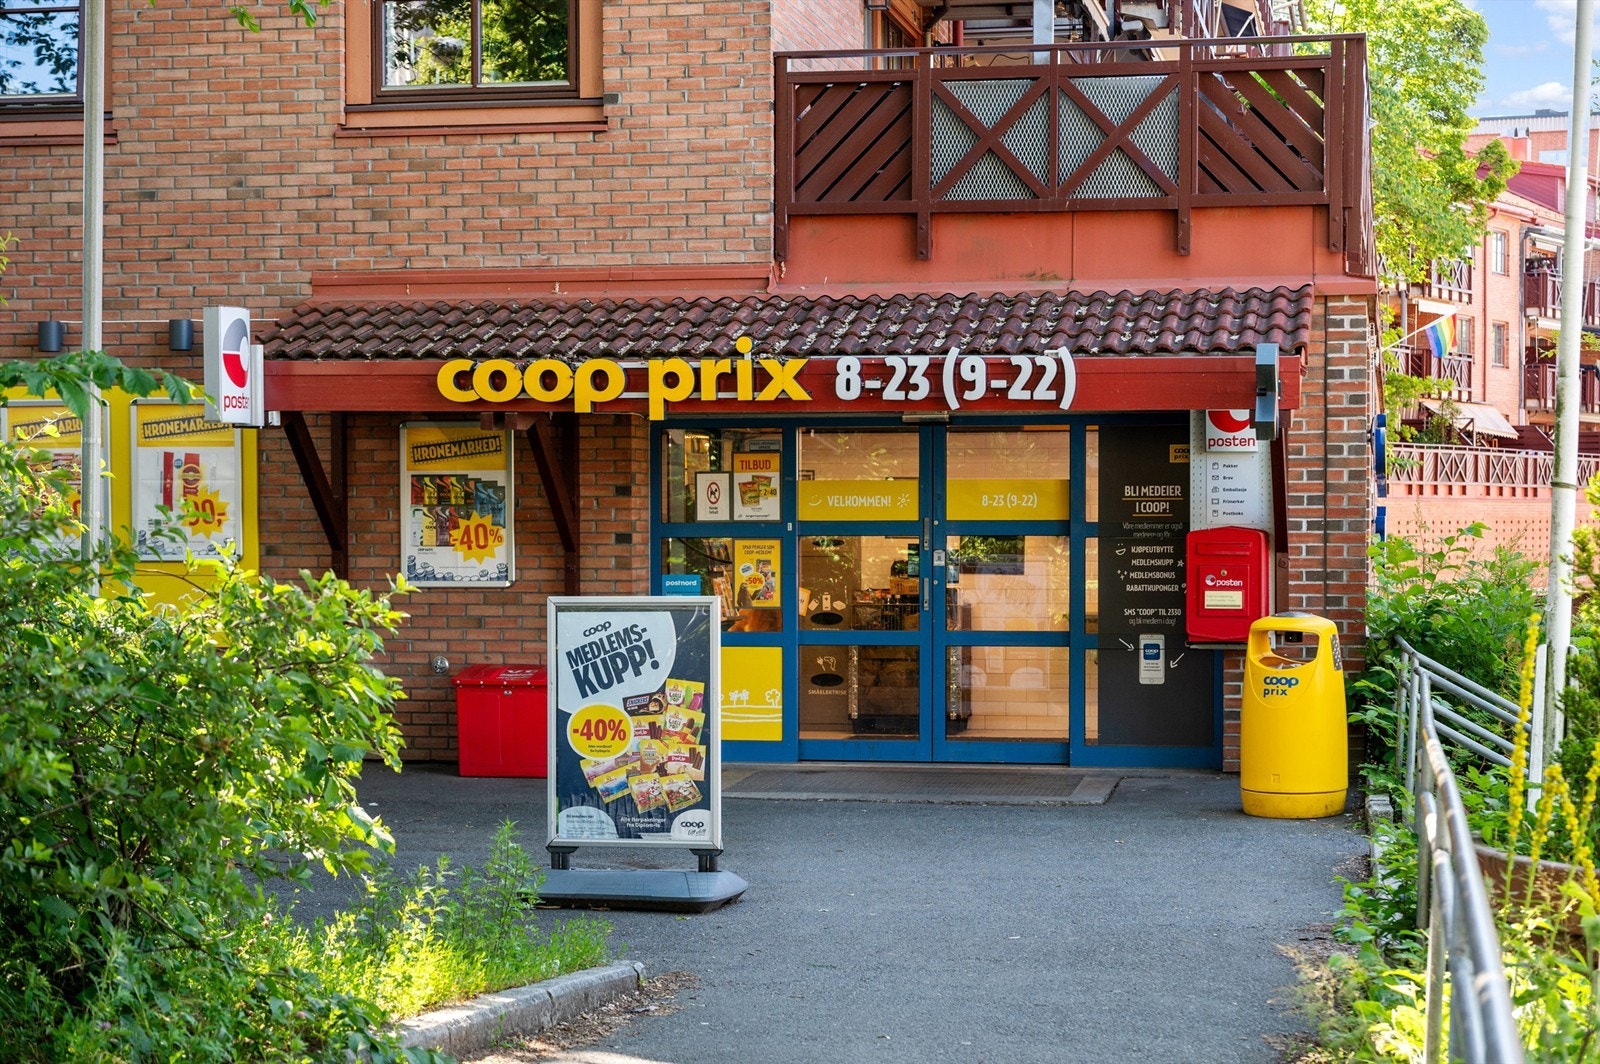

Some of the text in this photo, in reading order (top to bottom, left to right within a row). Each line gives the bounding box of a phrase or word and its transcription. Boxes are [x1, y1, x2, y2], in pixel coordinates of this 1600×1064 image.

[436, 336, 813, 421] coop prix
[835, 346, 1076, 410] 8-23 (9-22)
[224, 393, 250, 412] poste
[1208, 435, 1255, 449] posten
[413, 437, 501, 461] KRONEMARKED!
[739, 459, 771, 470] TILBUD
[1124, 485, 1182, 496] BLI MEDEIER
[827, 495, 892, 507] VELKOMMEN!
[981, 493, 1038, 508] 8-23 (9-22)
[1136, 502, 1170, 512] I COOP!
[451, 523, 503, 551] -40%
[1131, 545, 1174, 554] KJØPEUTBYTTE
[1131, 558, 1174, 566] MEDLEMSKUPP
[745, 577, 764, 585] -50%
[1129, 571, 1176, 579] MEDLEMSBONUS
[1126, 584, 1179, 592] RABATTKUPONGER
[1216, 579, 1243, 587] posten
[1124, 608, 1182, 616] SMS "COOP" TIL 2330
[583, 621, 612, 637] coop
[565, 623, 648, 669] MEDLEMS-
[571, 638, 660, 699] KUPP!
[1263, 676, 1299, 688] coop
[1263, 686, 1288, 698] prix
[572, 718, 627, 741] -40%
[681, 821, 704, 829] coop
